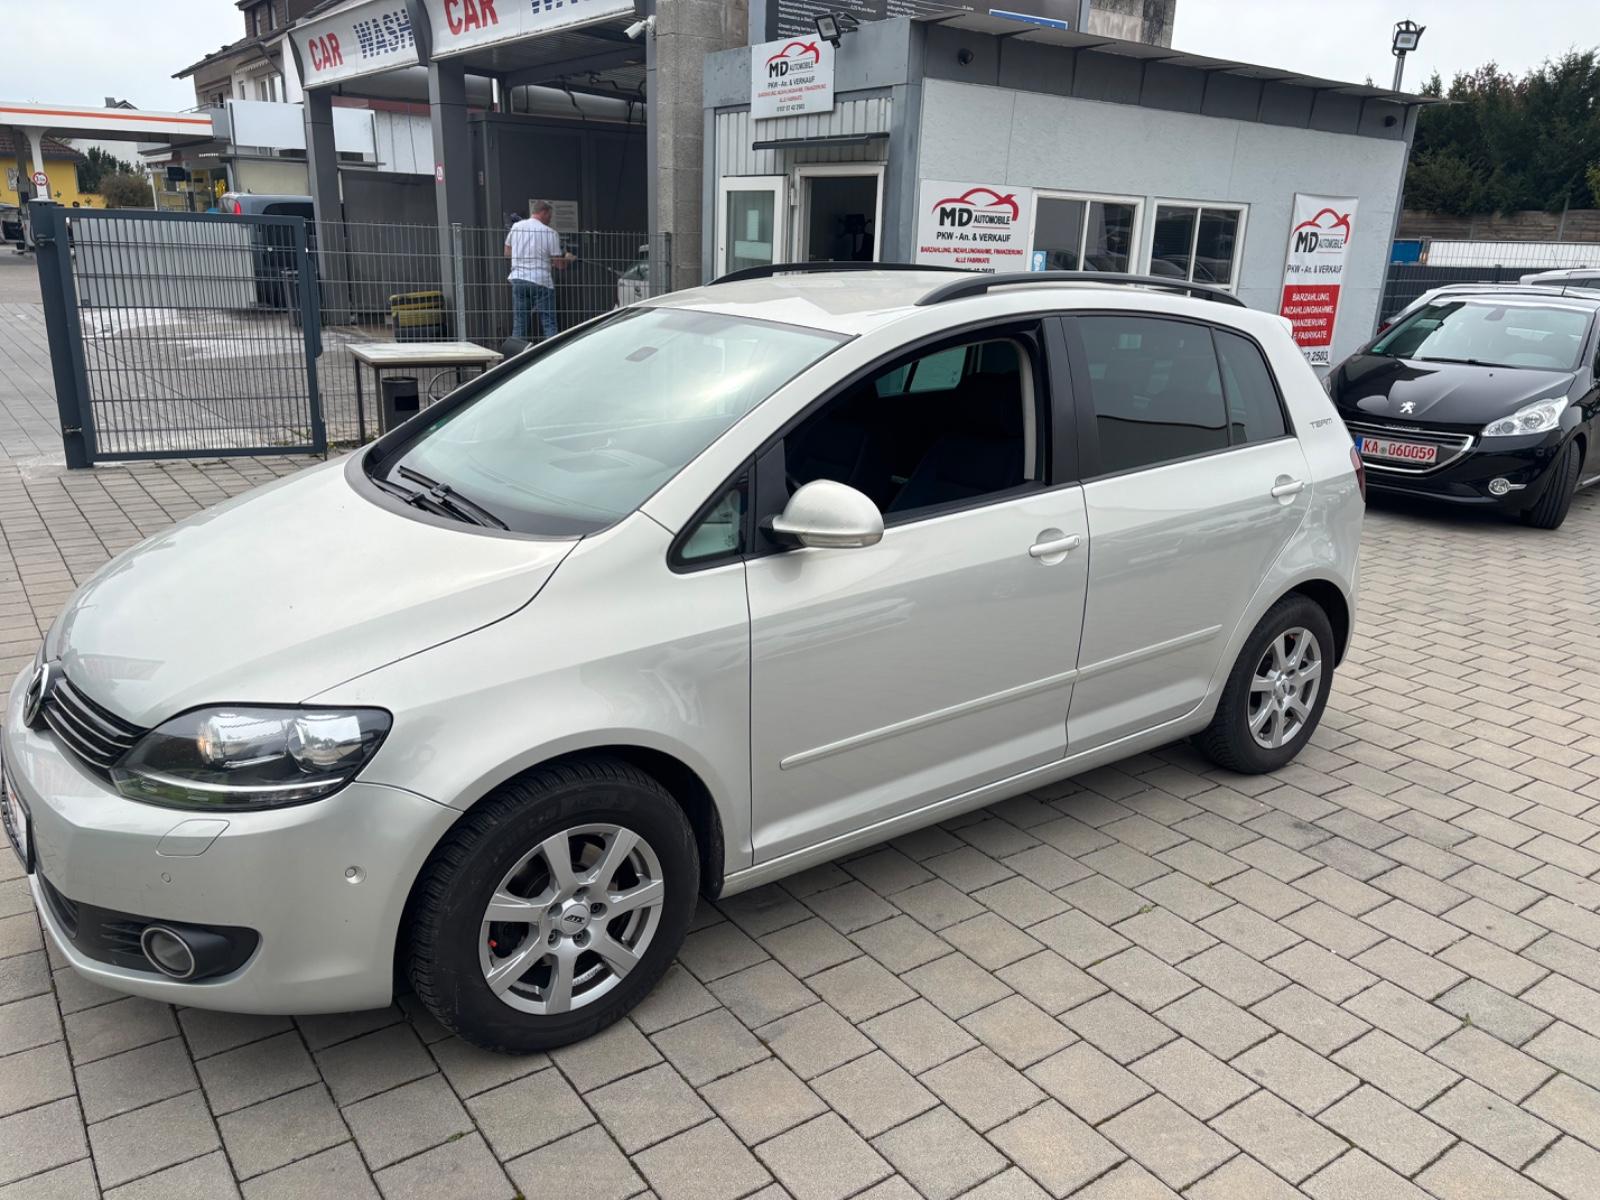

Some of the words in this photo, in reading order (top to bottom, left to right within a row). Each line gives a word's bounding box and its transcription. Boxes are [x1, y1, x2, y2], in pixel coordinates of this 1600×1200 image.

[444, 0, 498, 36] CAR
[308, 32, 344, 71] CAR
[353, 9, 414, 59] WASH
[769, 61, 789, 78] MD
[939, 207, 973, 227] MD
[973, 215, 1010, 225] AUTOMOBILE
[936, 231, 954, 241] PKW
[959, 233, 970, 241] An.
[972, 233, 977, 241] &
[979, 233, 1011, 243] VERKAUF
[1295, 231, 1319, 253] MD
[1319, 238, 1344, 249] AUTOMOBILE
[1287, 264, 1301, 273] PKW
[1319, 264, 1342, 274] VERKAUF
[1299, 331, 1327, 339] FABRIKATE
[1311, 350, 1328, 361] 2503
[1309, 417, 1333, 430] TEAM
[1363, 439, 1379, 454] KA
[1388, 443, 1435, 460] 060059
